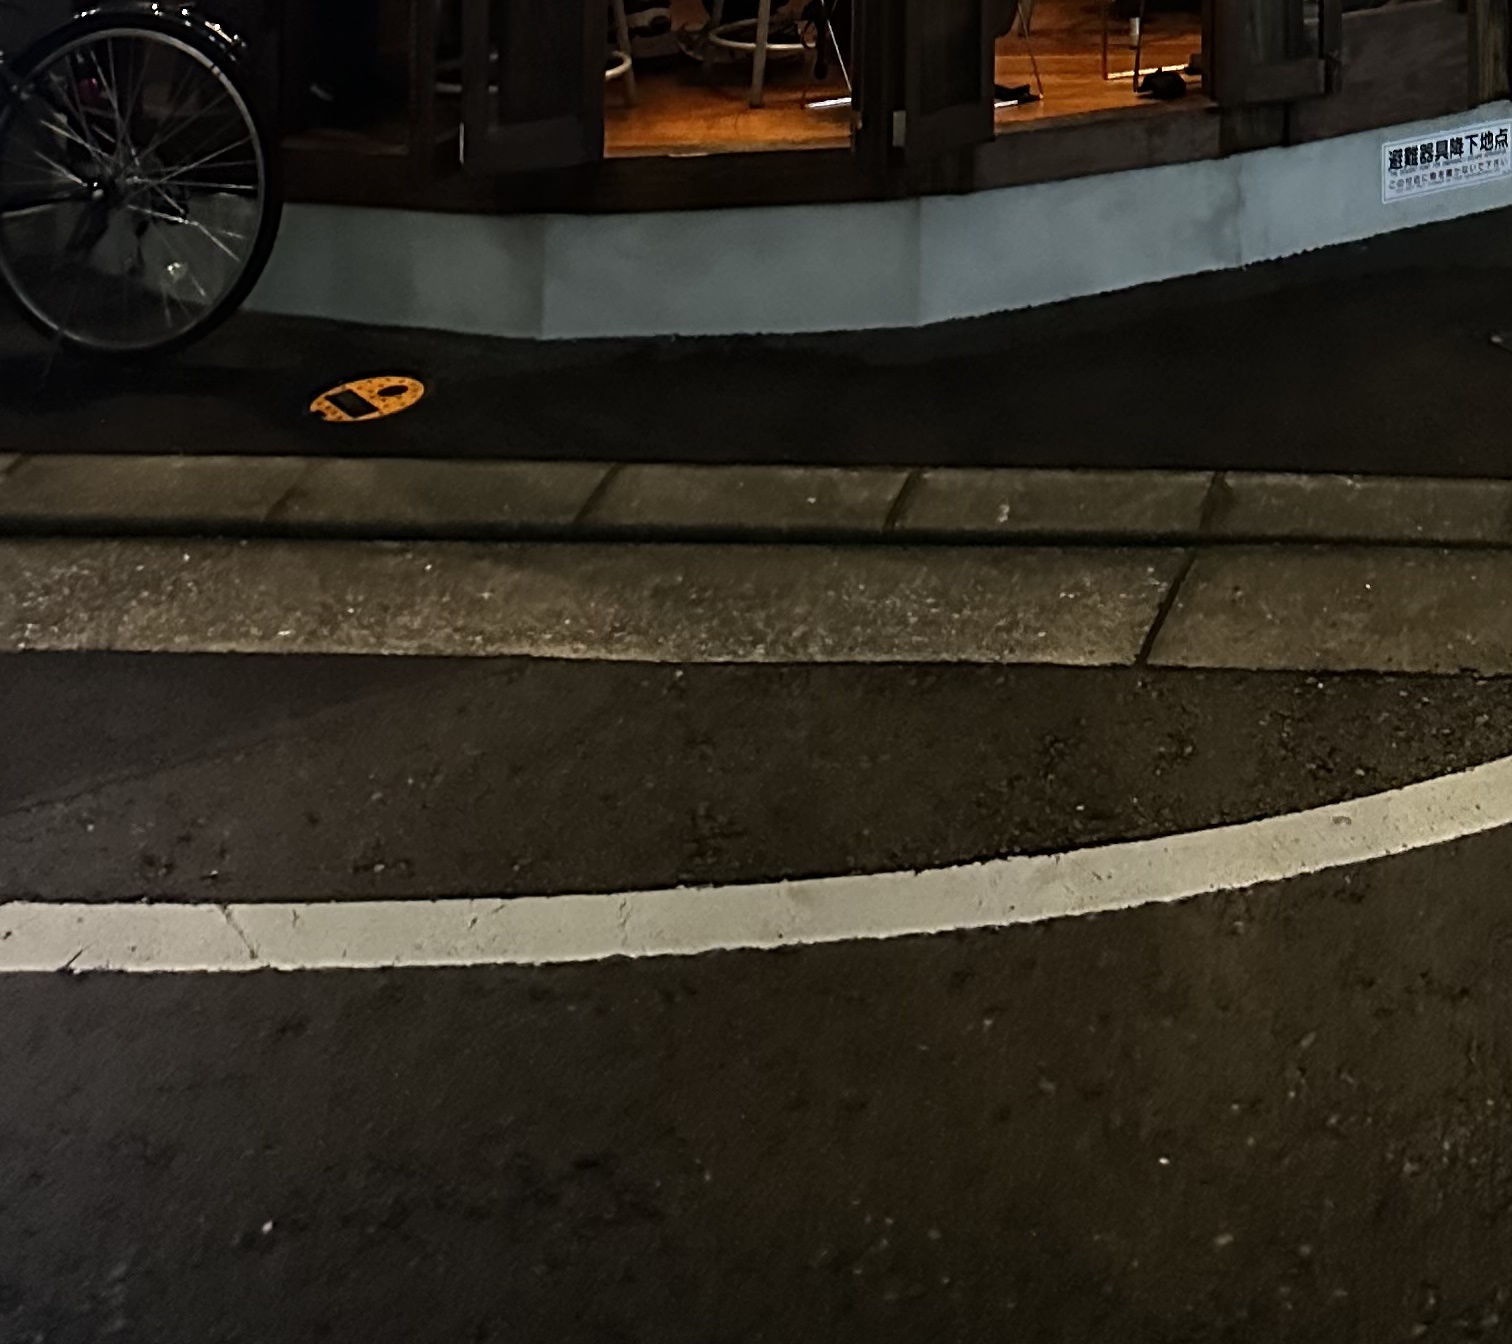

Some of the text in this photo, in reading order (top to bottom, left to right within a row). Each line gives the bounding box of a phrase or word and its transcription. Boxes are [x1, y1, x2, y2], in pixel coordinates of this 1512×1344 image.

[1388, 128, 1509, 171] 避難器具降下地点
